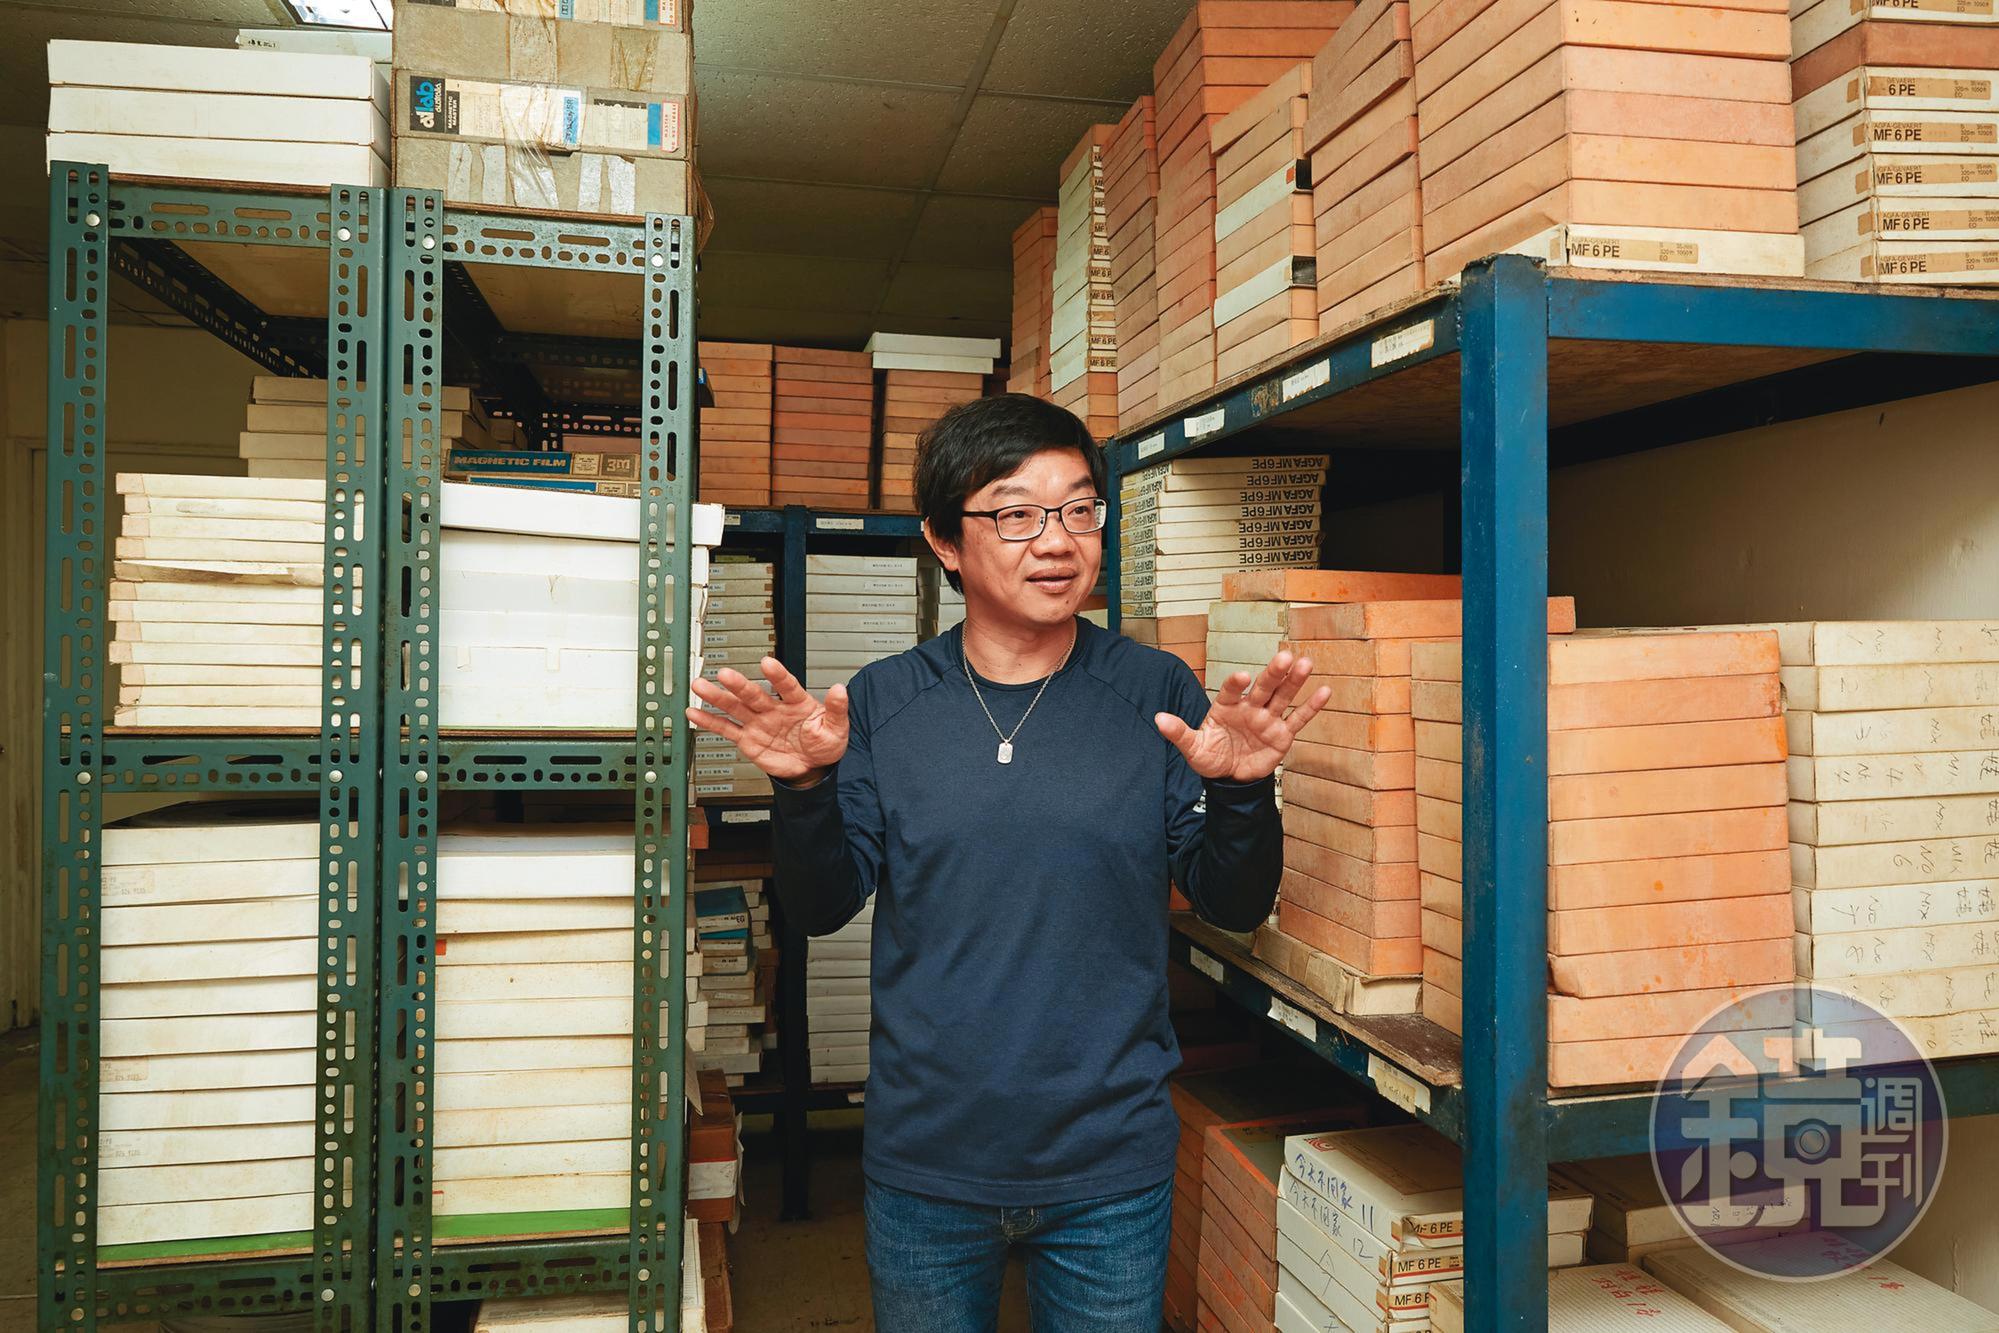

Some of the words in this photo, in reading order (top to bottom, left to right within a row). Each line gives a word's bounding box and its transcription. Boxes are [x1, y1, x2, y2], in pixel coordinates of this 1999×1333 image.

[1889, 84, 1896, 95] 6
[1899, 84, 1915, 95] PE
[1874, 129, 1891, 141] MF
[1895, 129, 1902, 141] 6
[1905, 129, 1921, 140] PE
[1896, 173, 1902, 183] 6
[1906, 172, 1922, 183] PE
[1883, 219, 1900, 230] MF
[1903, 219, 1910, 230] 6
[1913, 218, 1929, 229] PE
[1571, 244, 1590, 256] MF
[1593, 245, 1600, 256] 6
[1603, 245, 1620, 258] PE
[1880, 262, 1897, 274] MF
[1900, 262, 1907, 273] 6
[1910, 261, 1926, 272] PE
[454, 456, 530, 466] MAGNETIC
[533, 458, 566, 467] FILM
[606, 459, 630, 472] 3M
[1293, 457, 1323, 468] AGFA
[1289, 473, 1319, 484] AGFA
[1283, 489, 1314, 500] AGFA
[1284, 504, 1314, 516] AGFA
[1282, 519, 1313, 531] AGFA
[1282, 534, 1313, 546] AGFA
[1282, 550, 1313, 562] AGFA
[1886, 767, 1904, 787] 4
[1892, 854, 1913, 867] 6
[1917, 890, 1933, 921] Mix
[1431, 1223, 1437, 1233] 6
[1440, 1222, 1453, 1232] PE
[1352, 1238, 1374, 1259] 12
[1398, 1261, 1414, 1272] MF
[1418, 1259, 1425, 1269] 6
[1428, 1258, 1440, 1268] PE
[1395, 1295, 1411, 1305] MF
[1415, 1293, 1421, 1303] 6
